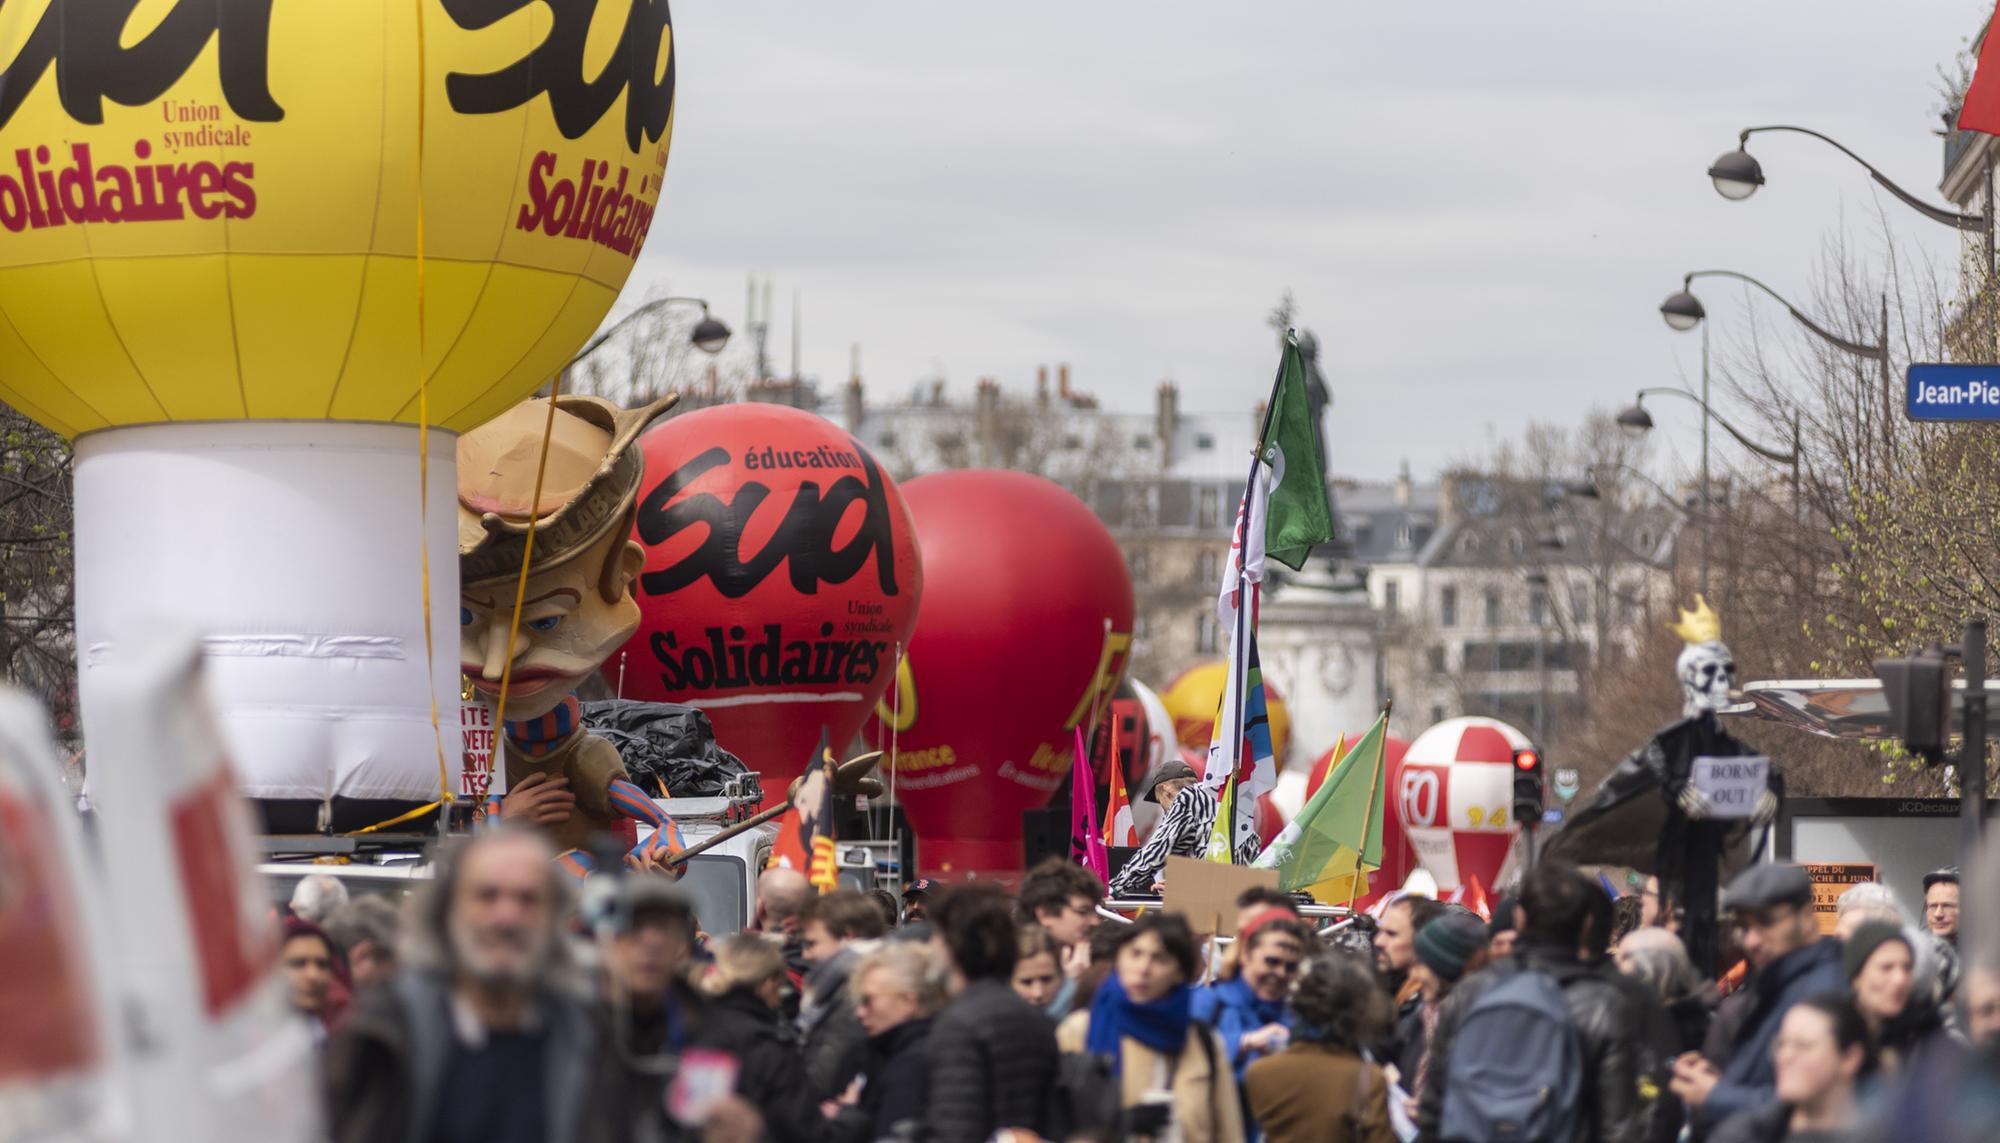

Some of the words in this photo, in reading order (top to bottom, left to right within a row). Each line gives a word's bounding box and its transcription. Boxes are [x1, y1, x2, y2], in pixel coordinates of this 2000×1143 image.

[163, 100, 221, 123] Union
[163, 124, 252, 154] syndicale
[1916, 380, 2000, 405] Jean-Pie
[745, 445, 862, 471] éducation
[847, 600, 883, 615] Union
[843, 620, 894, 635] syndicale
[650, 621, 888, 692] Solidaires
[1711, 764, 1761, 779] BORNE
[1897, 801, 1961, 813] JCDecaux
[1832, 866, 1845, 874] DU
[1850, 874, 1871, 882] JUIN
